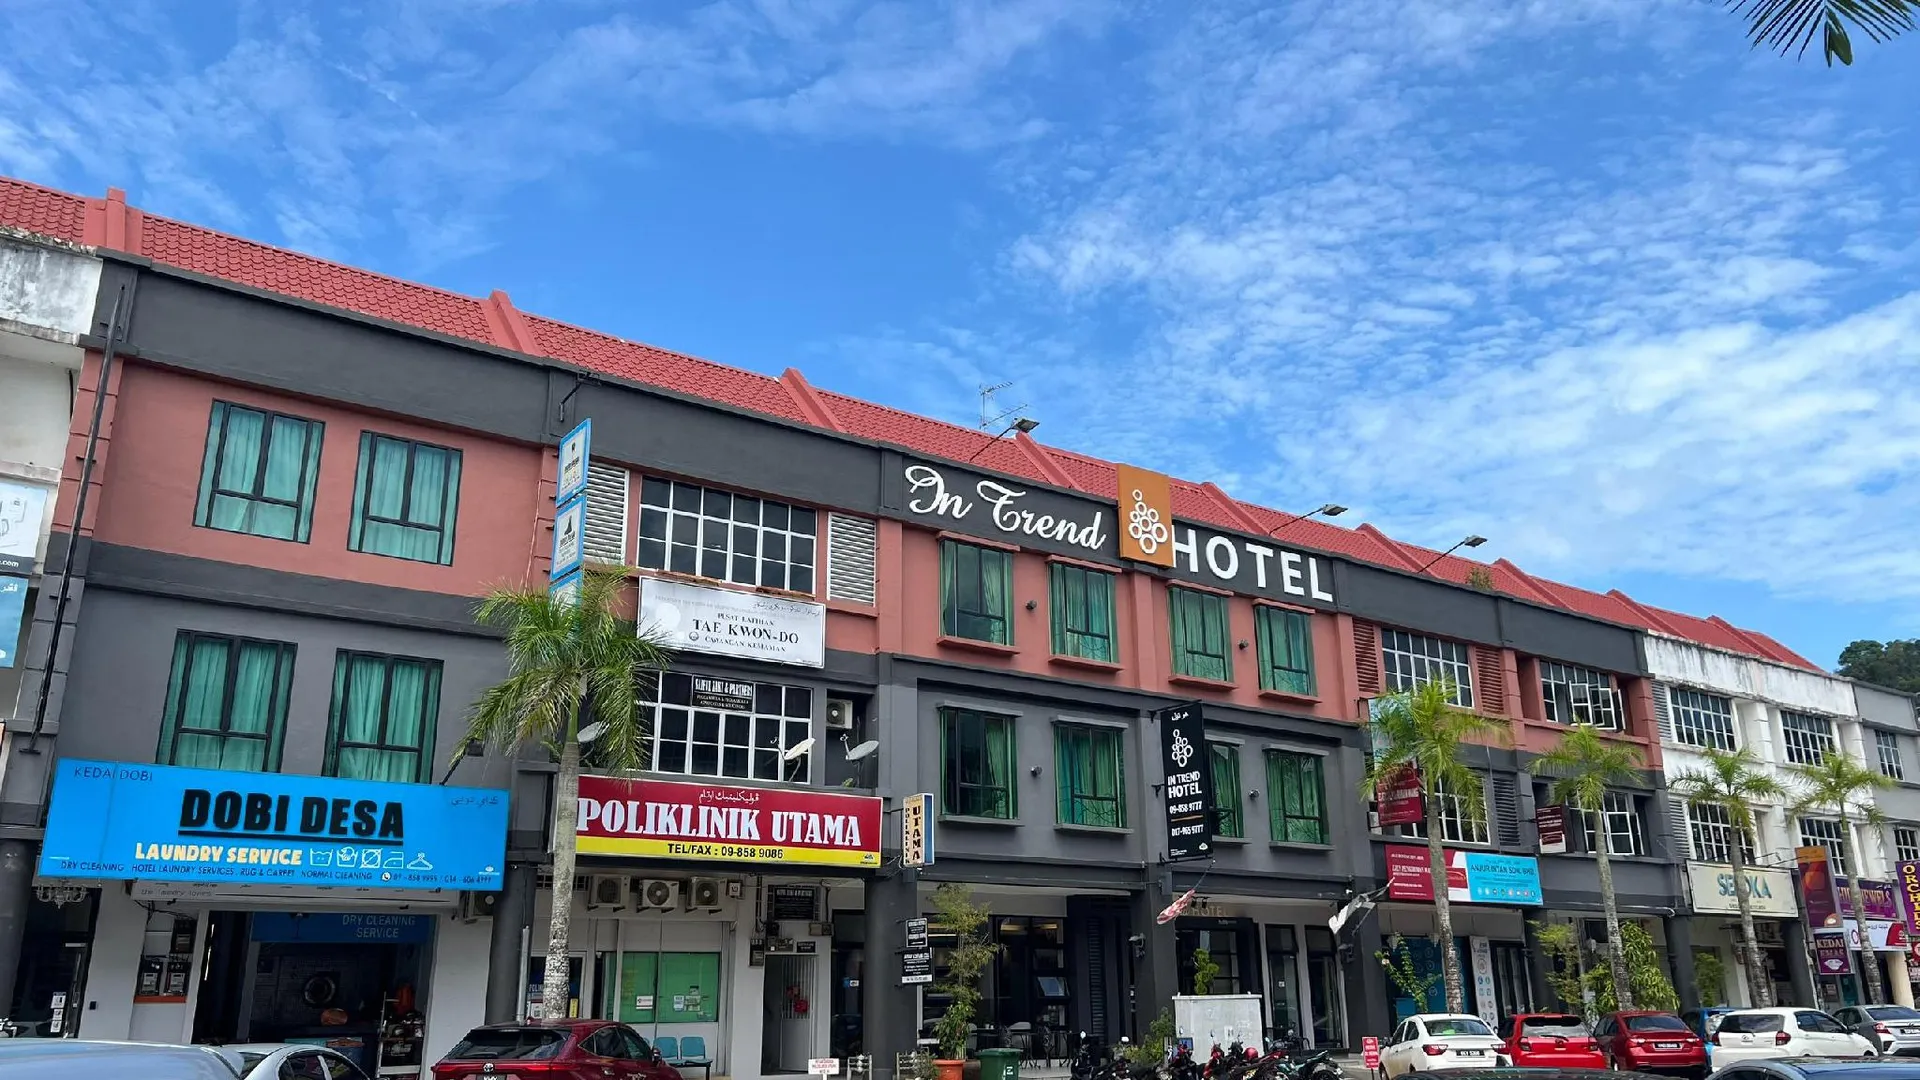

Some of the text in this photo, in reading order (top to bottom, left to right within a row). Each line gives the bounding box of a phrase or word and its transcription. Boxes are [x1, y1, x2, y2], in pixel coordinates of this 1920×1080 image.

[904, 465, 1333, 602] In Trend HOTEL
[692, 618, 799, 644] TAE KWON-DO
[74, 766, 153, 782] KEDAI DOBI
[1167, 770, 1201, 786] IN TREND
[1168, 781, 1203, 799] HOTEL
[179, 788, 404, 839] DOBI DESA
[577, 797, 862, 847] POLIKLINIK UTAMA
[912, 805, 921, 861] UTAMA
[135, 842, 303, 866] LAUNDRY SERVICE
[667, 843, 712, 856] TEL/FAX
[721, 846, 756, 858] 09-858
[758, 847, 783, 859] 9086
[80, 861, 125, 872] CLEANING
[131, 863, 157, 873] HOTEL
[240, 867, 257, 877] RUG
[343, 914, 417, 926] DRY CLEANING
[356, 927, 399, 938] SERVICE
[1816, 938, 1844, 949] KEDAI
